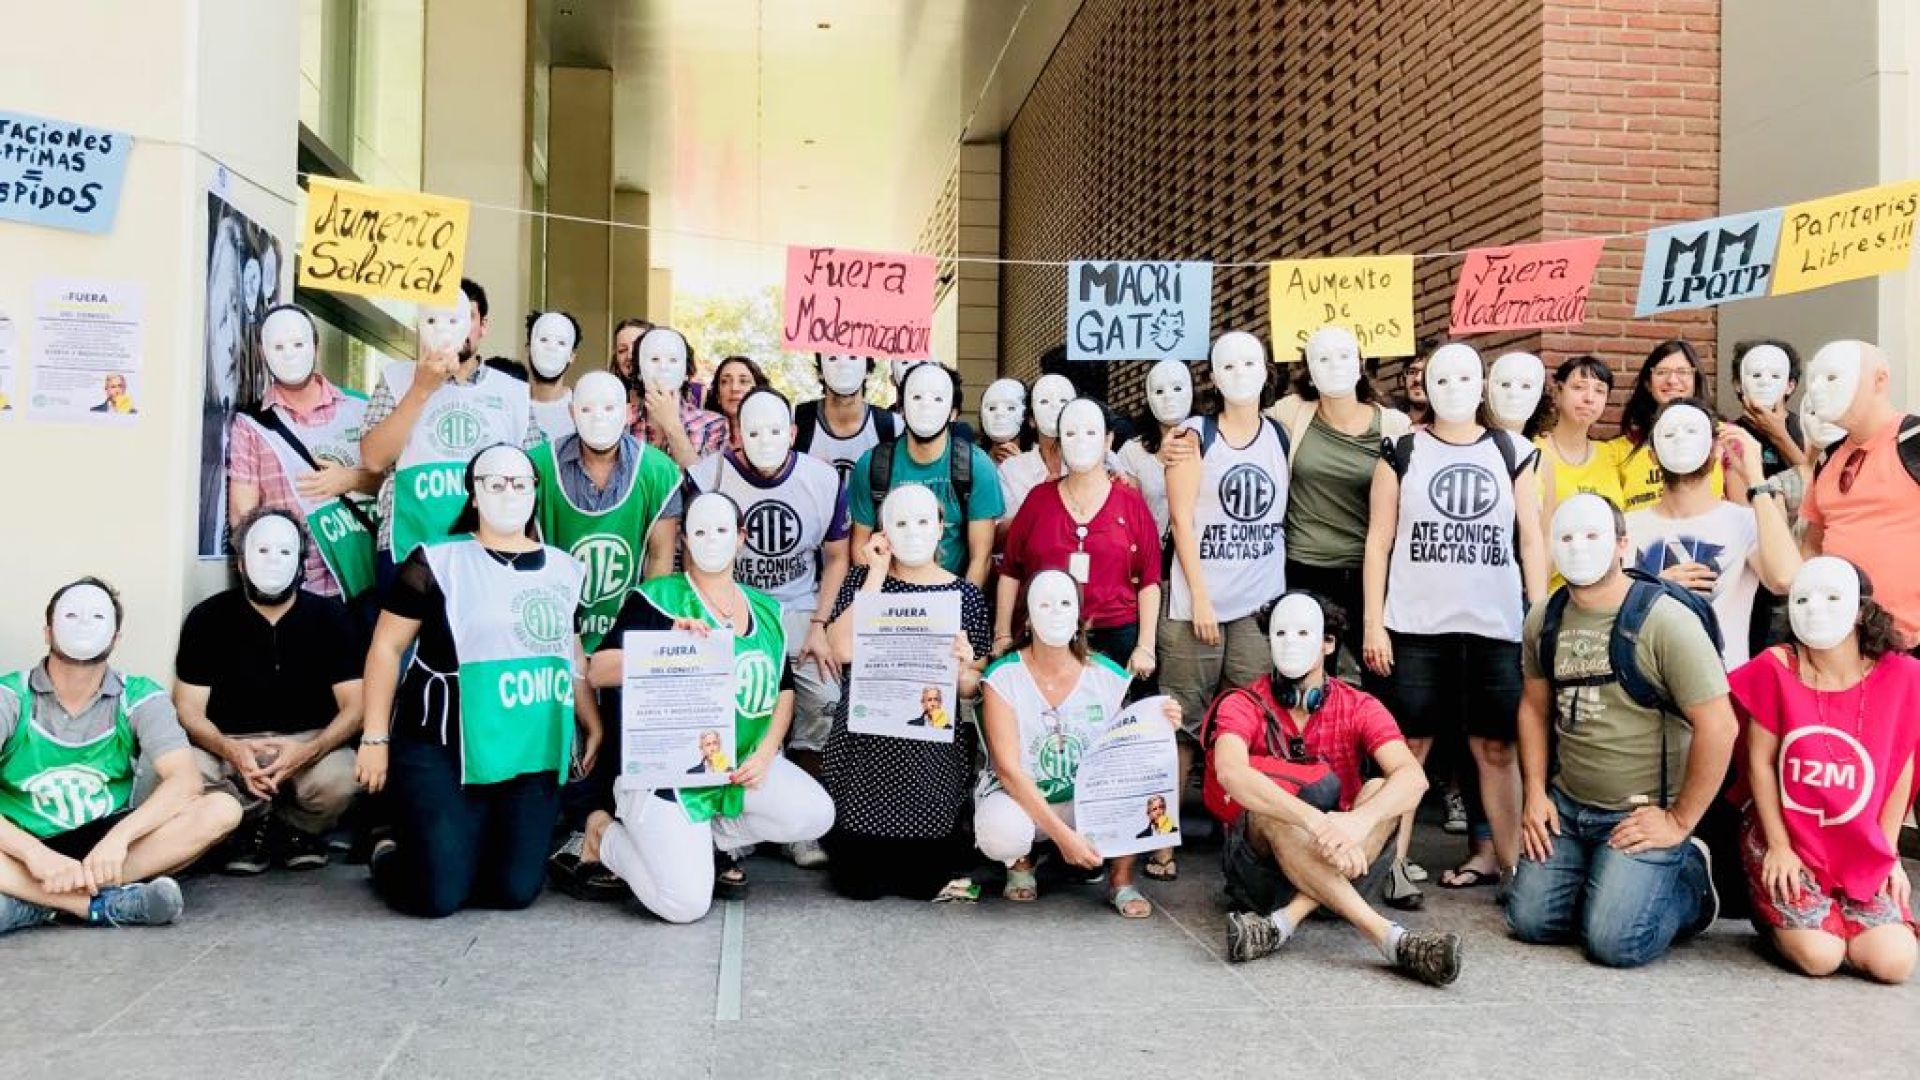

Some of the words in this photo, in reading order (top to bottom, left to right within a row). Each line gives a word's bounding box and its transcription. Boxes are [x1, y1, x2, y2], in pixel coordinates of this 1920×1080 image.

[0, 143, 86, 172] PTiMAS
[315, 191, 454, 250] Aumento
[1792, 193, 1918, 244] Paritarias
[308, 241, 454, 294] Salarial
[1475, 250, 1568, 285] Fuera
[1663, 221, 1760, 280] MM
[1801, 219, 1913, 273] Libres!!!
[804, 248, 907, 294] Fuera
[1657, 263, 1770, 306] LPQTP
[1296, 318, 1400, 352] SRIOS
[1224, 468, 1270, 517] ATE
[1435, 468, 1493, 515] ATE
[746, 504, 796, 552] ATE
[1202, 525, 1227, 542] ATE
[1412, 522, 1439, 542] ATE
[1444, 522, 1504, 545] CONICE
[1200, 541, 1261, 561] EXACTAS
[1410, 543, 1476, 564] EXACTAS
[1481, 545, 1510, 568] UBA
[1788, 757, 1856, 790] 12M
